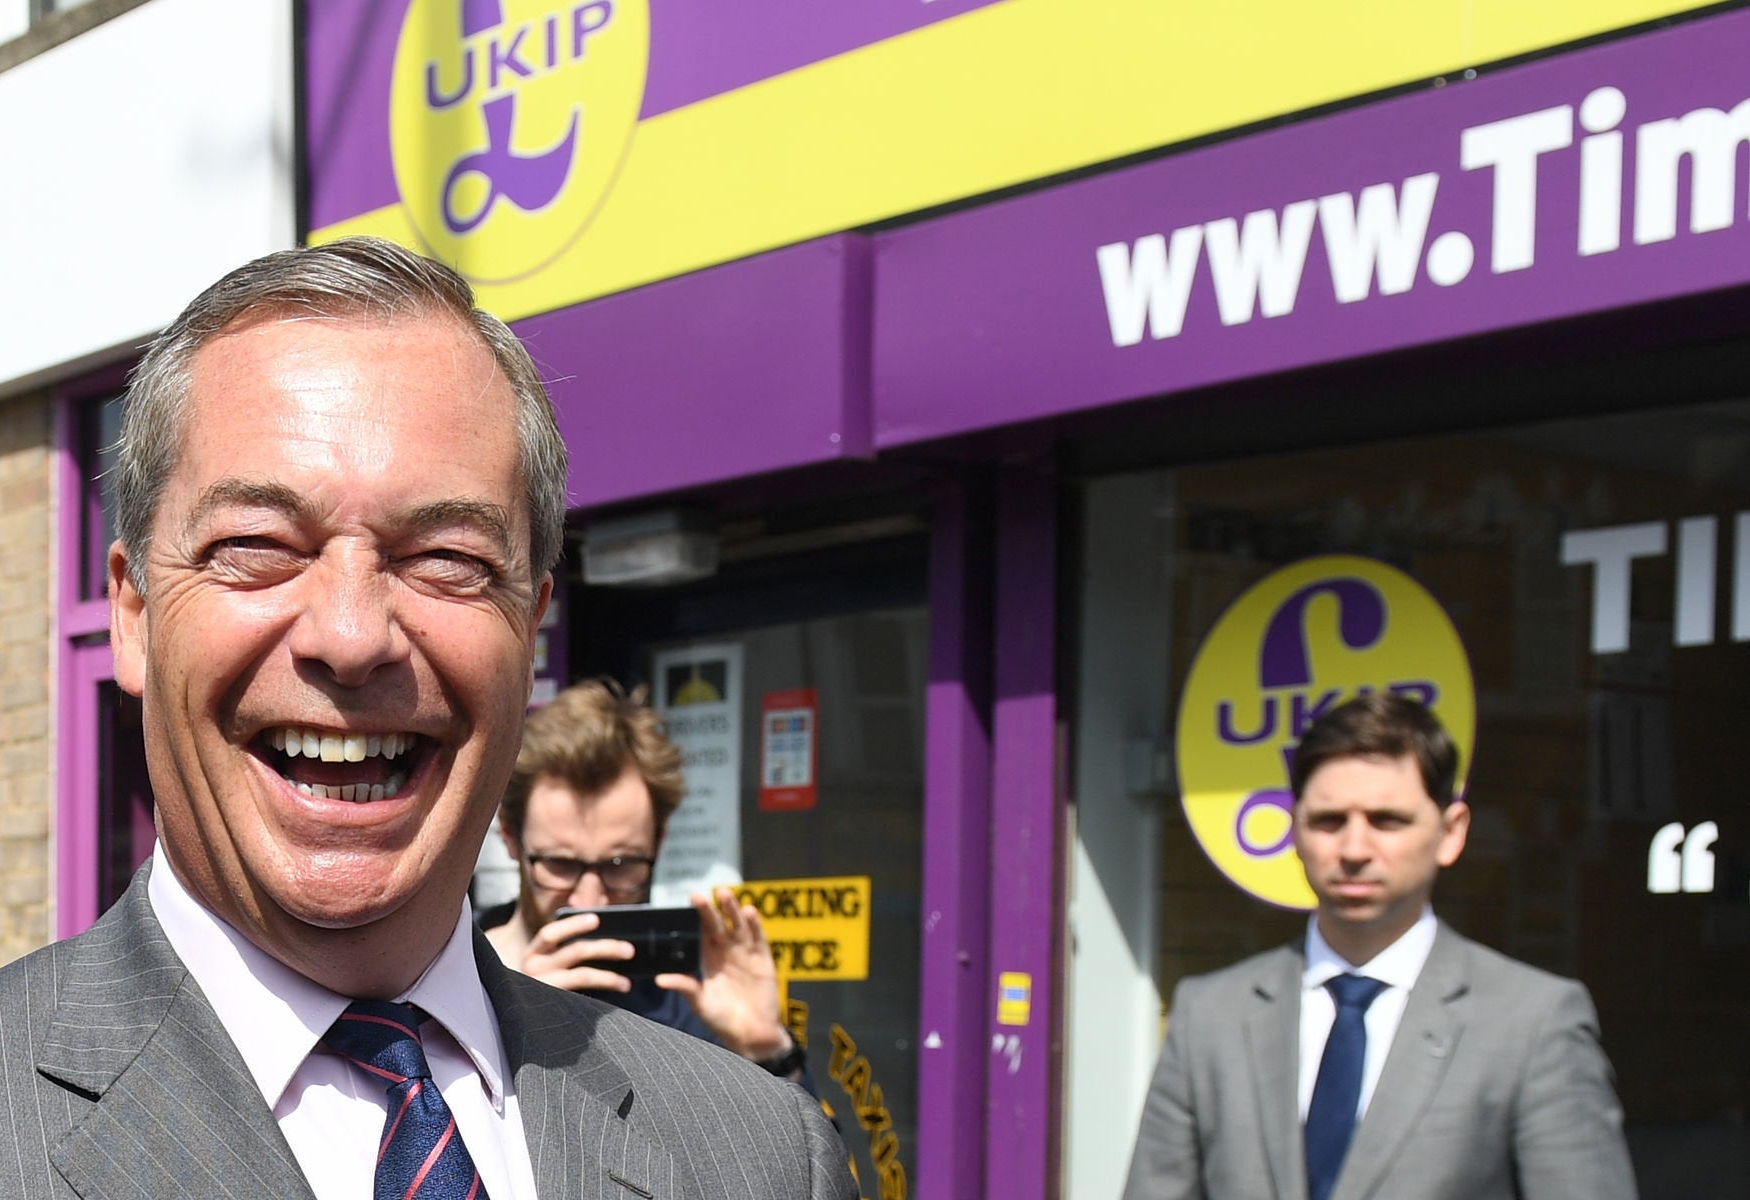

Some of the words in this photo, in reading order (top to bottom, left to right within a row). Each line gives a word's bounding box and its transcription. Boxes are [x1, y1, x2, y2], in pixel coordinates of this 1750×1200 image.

[426, 0, 612, 109] UKIP
[1560, 511, 1750, 655] TI
[737, 886, 861, 919] OOKING
[772, 940, 839, 971] FICE
